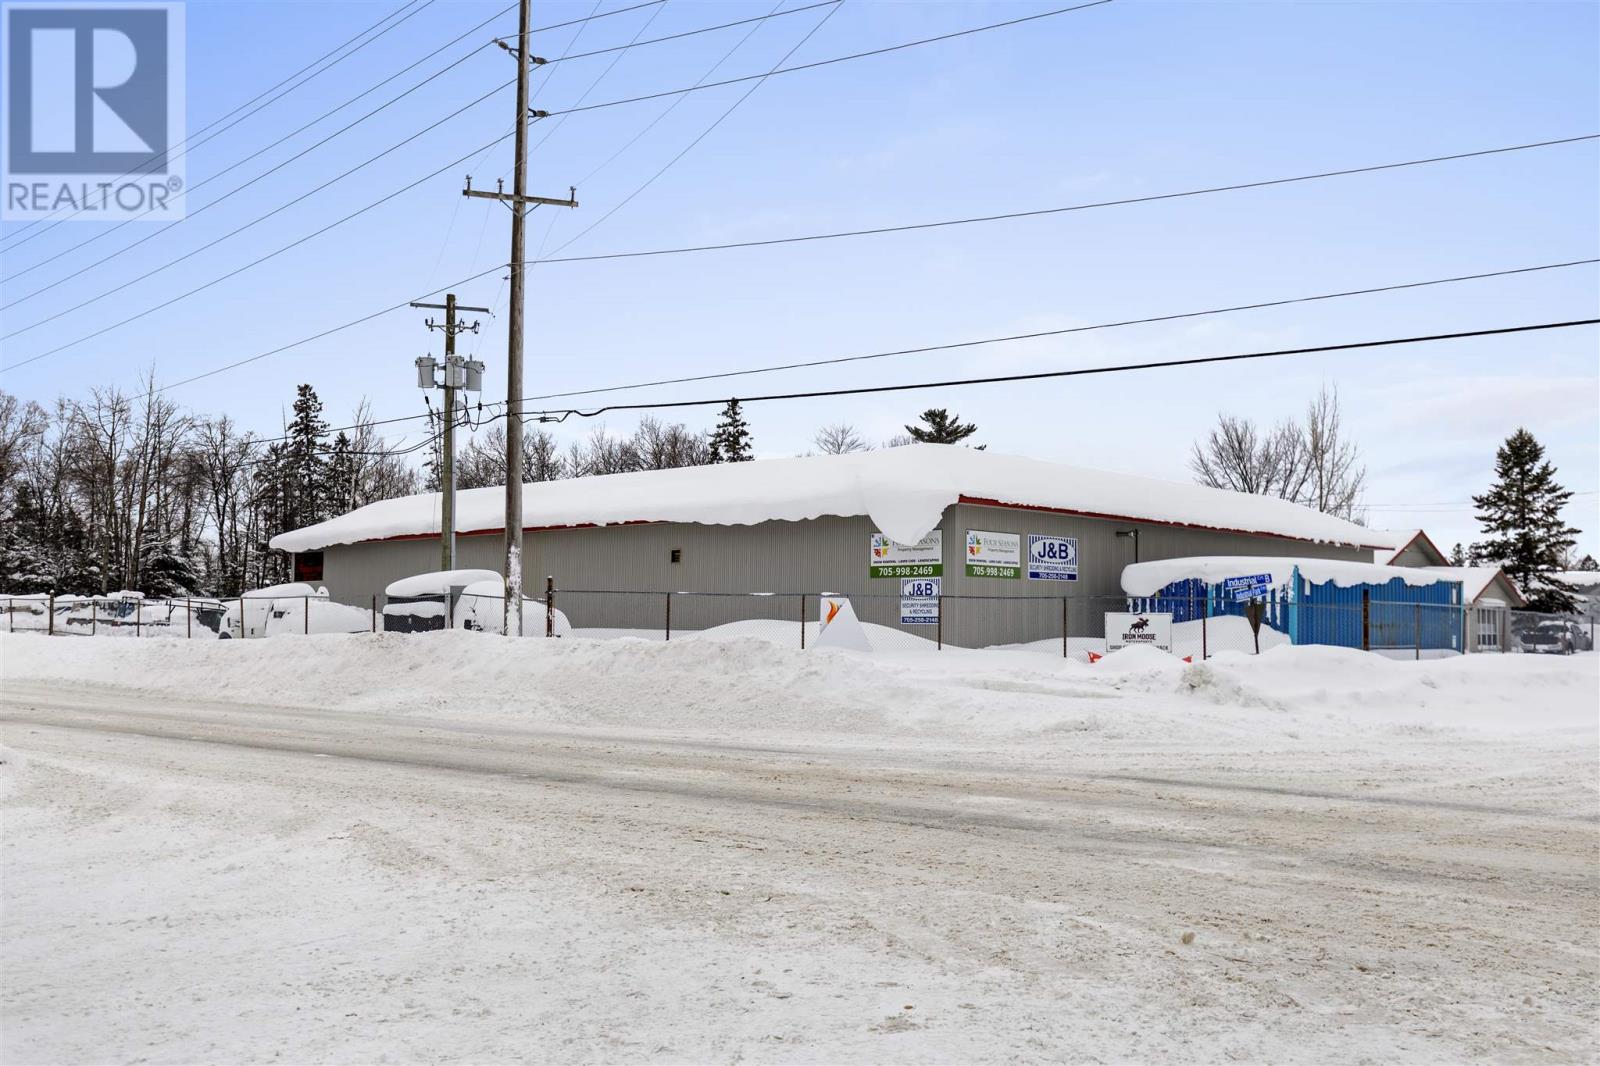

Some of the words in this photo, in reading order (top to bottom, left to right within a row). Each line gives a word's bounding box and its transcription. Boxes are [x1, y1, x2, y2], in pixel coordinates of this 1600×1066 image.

[1038, 542, 1068, 560] J&B
[878, 566, 934, 576] 705-998-2469
[972, 566, 1014, 576] 705-998-2469
[1226, 577, 1257, 587] Industrial
[1264, 574, 1270, 583] B
[909, 583, 932, 596] J&B
